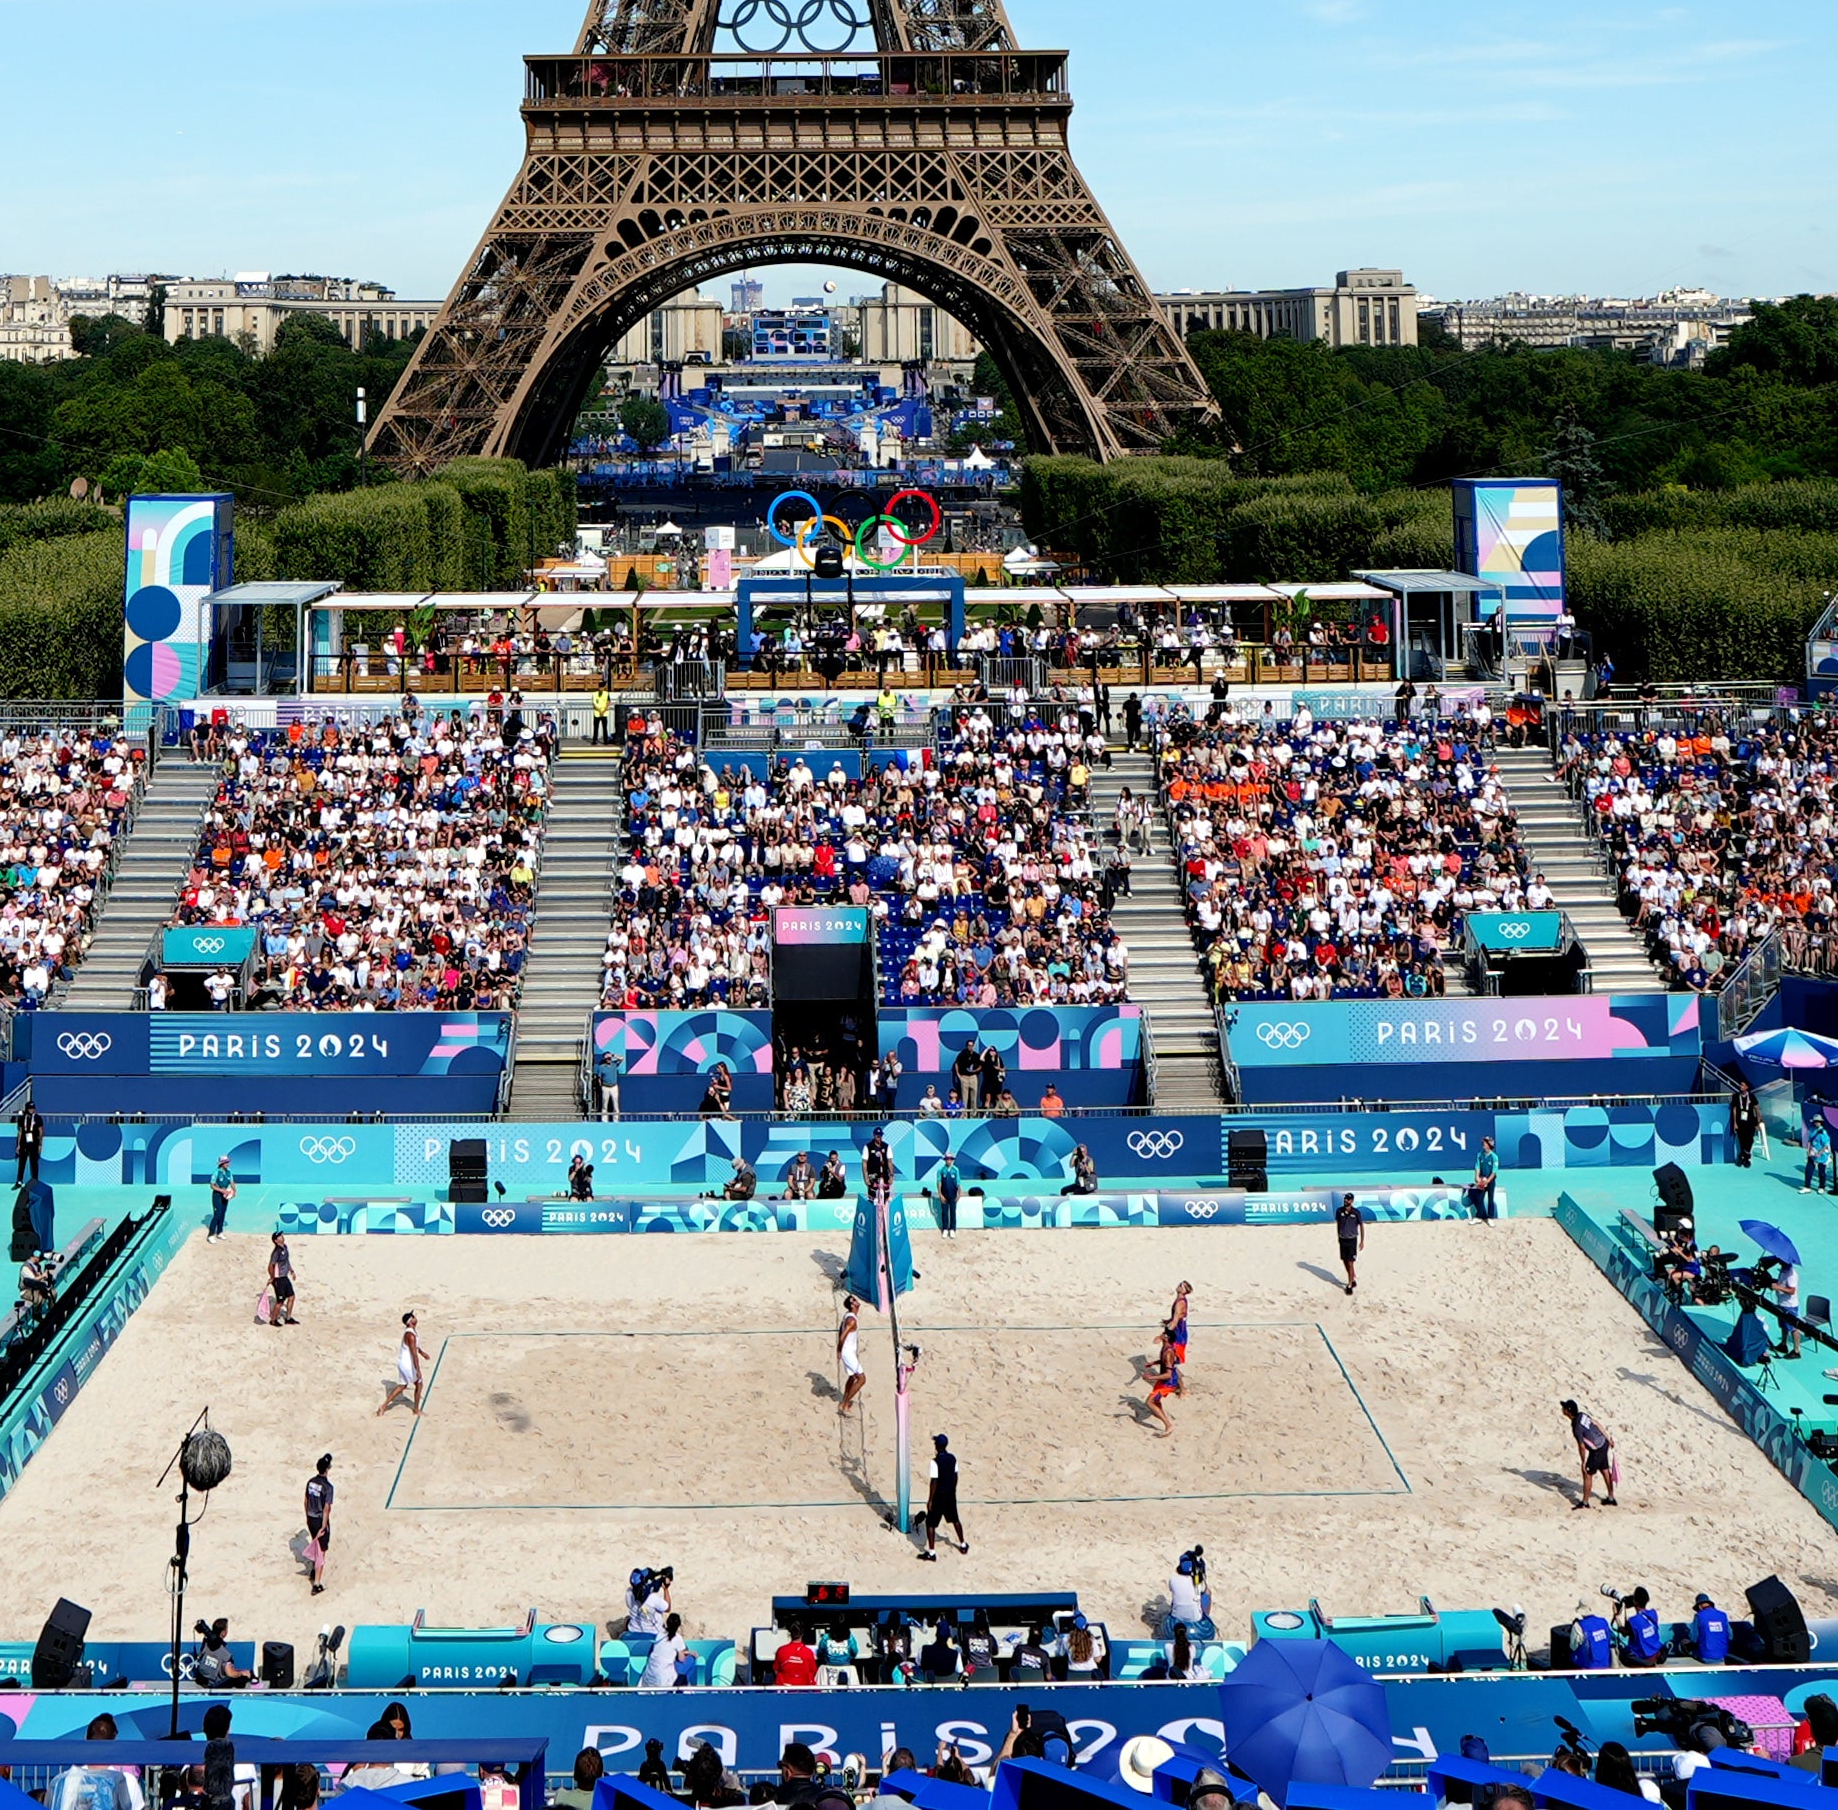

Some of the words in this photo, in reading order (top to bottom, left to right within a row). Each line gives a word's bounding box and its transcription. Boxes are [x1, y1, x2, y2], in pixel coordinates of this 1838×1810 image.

[826, 920, 862, 930] 2024
[1492, 1018, 1582, 1042] 2024
[296, 1034, 388, 1057] 2024
[1372, 1126, 1467, 1153] 2024
[546, 1139, 641, 1164] 2024
[1293, 1202, 1327, 1212] 2024
[590, 1212, 624, 1222] 2024
[1386, 1654, 1429, 1668] 2024
[475, 1666, 518, 1679] 2024
